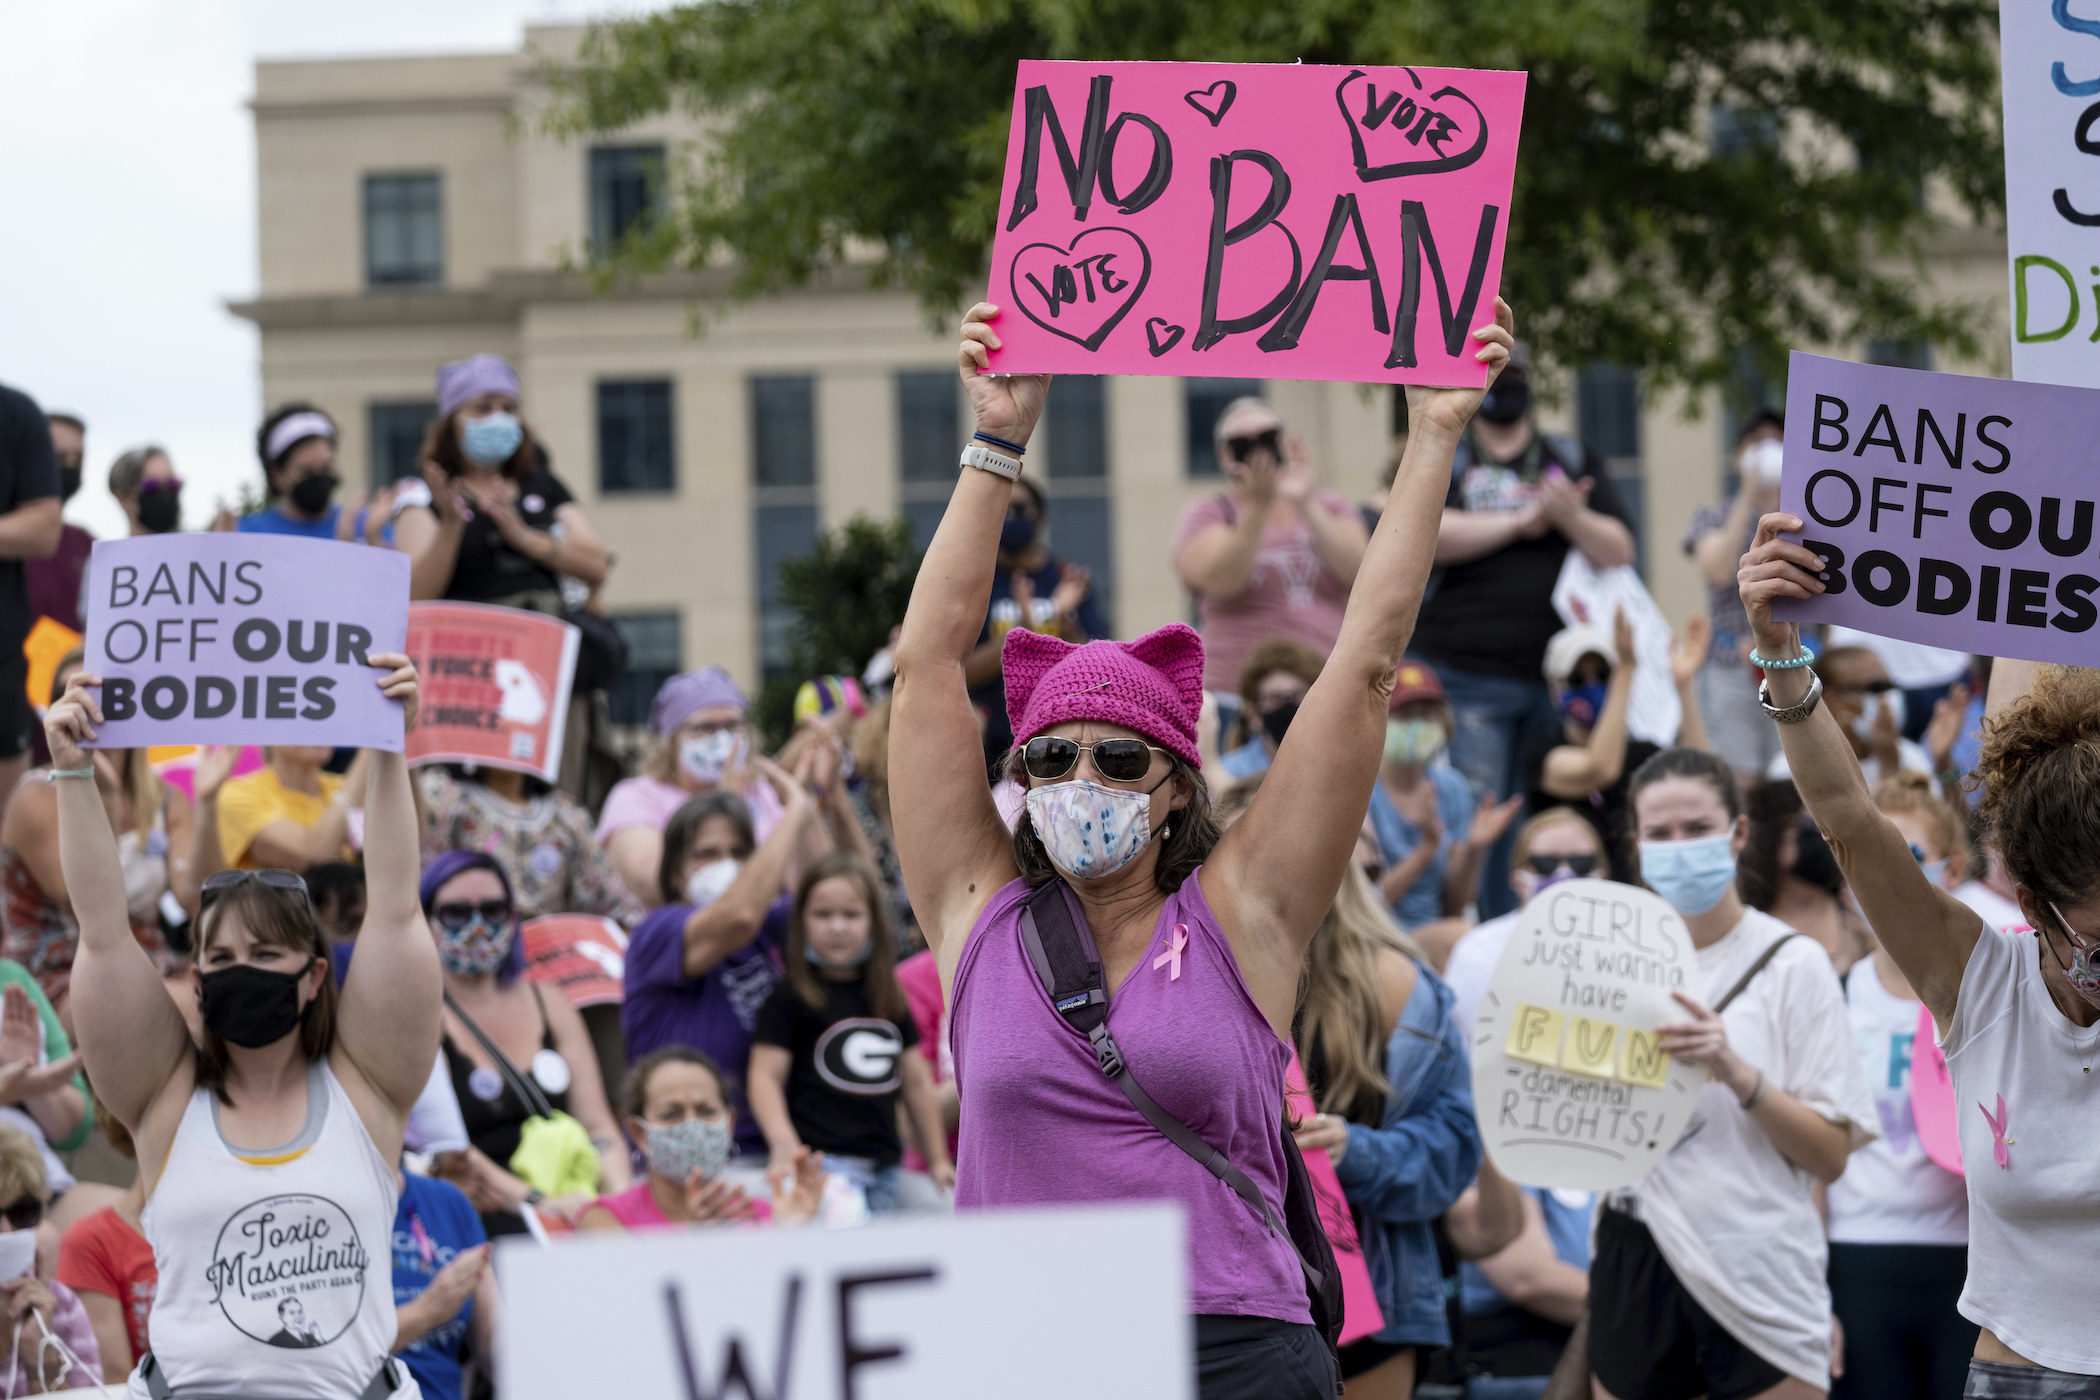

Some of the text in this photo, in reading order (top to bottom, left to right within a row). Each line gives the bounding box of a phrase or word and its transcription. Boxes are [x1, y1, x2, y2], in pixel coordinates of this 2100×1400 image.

[1006, 75, 1173, 232] NO
[1361, 83, 1462, 159] VOTE
[1025, 253, 1129, 318] VOTE
[1192, 148, 1499, 368] BAN
[1811, 393, 2013, 475] BANS
[1804, 469, 2100, 561] OFF OU
[109, 560, 263, 608] BANS
[1802, 539, 2100, 633] BODIES
[104, 618, 219, 665] OFF
[232, 617, 372, 667] OUR
[101, 675, 338, 722] BODIES
[1521, 927, 1686, 990] just wanna
[1549, 891, 1679, 964] GIRLS
[1560, 973, 1628, 1012] have
[1499, 1087, 1665, 1150] RIGHTS!
[242, 1212, 330, 1259] Toxic
[206, 1236, 370, 1304] Masculinity
[250, 1289, 278, 1302] RUINS
[281, 1284, 298, 1296] THE
[299, 1279, 329, 1292] PARTY
